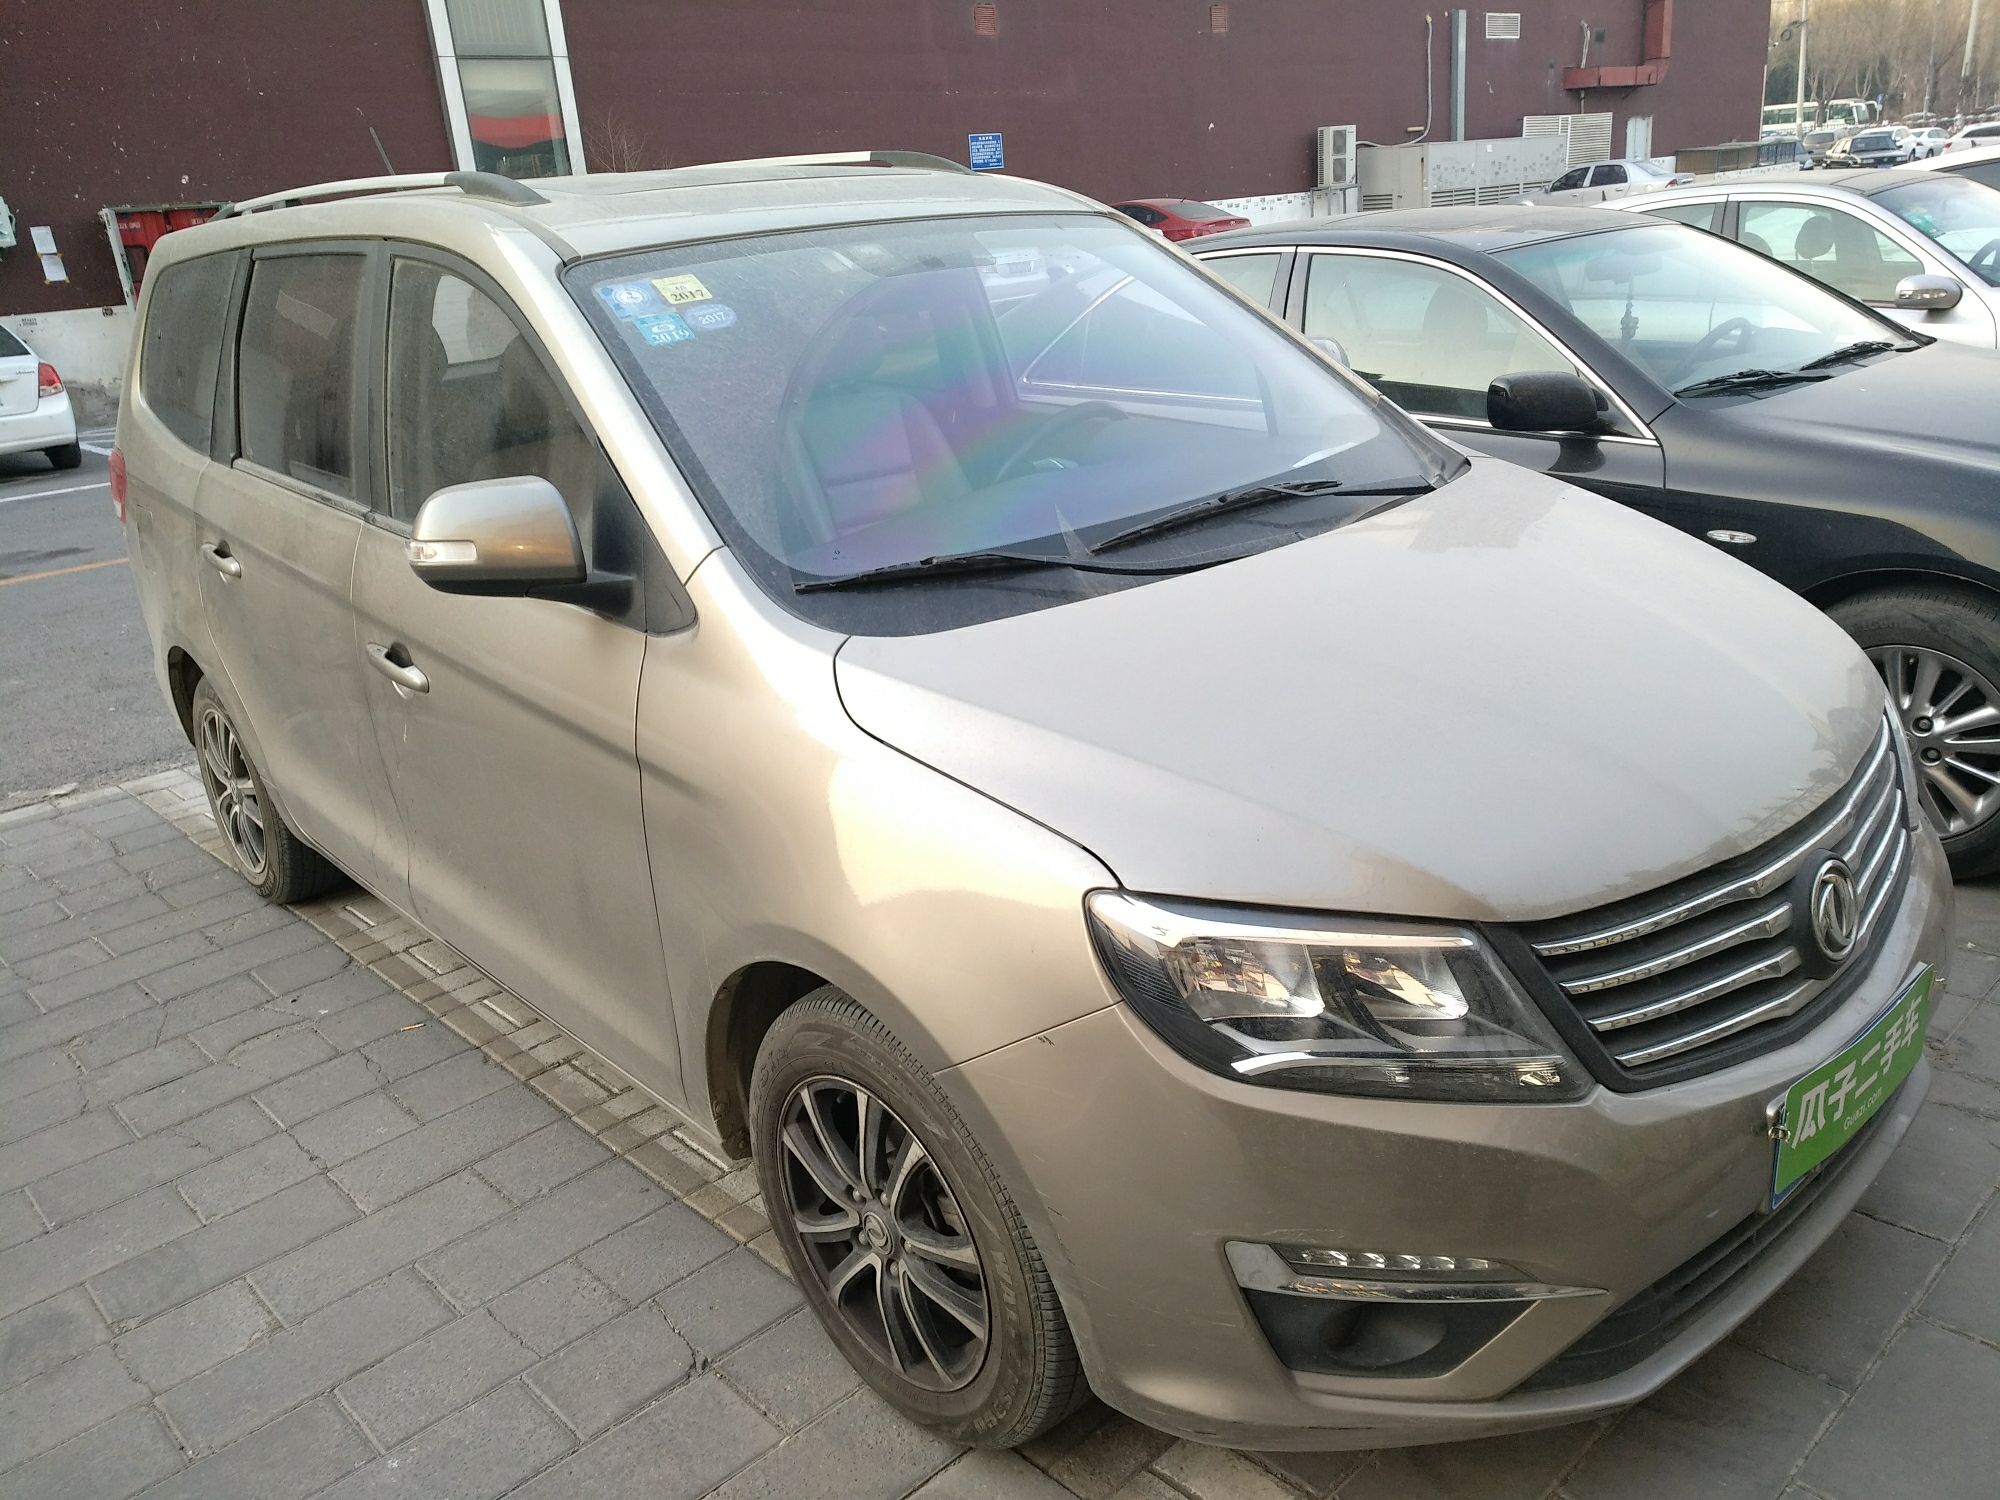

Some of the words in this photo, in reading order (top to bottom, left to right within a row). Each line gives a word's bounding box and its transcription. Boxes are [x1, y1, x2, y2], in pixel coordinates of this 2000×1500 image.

[671, 289, 704, 302] 2017
[698, 311, 725, 325] 2017
[1791, 995, 1922, 1150] 瓜子二手车
